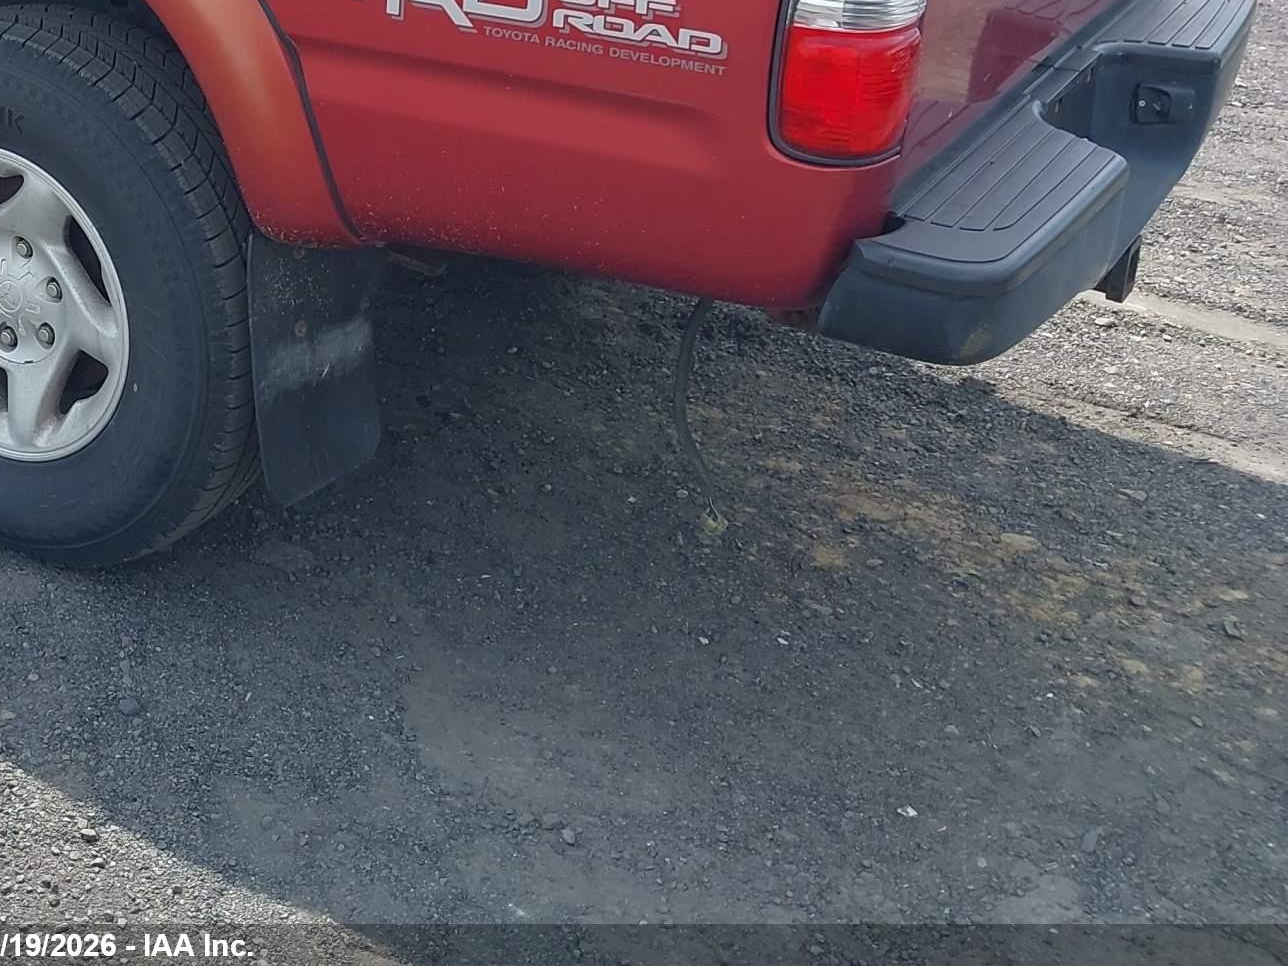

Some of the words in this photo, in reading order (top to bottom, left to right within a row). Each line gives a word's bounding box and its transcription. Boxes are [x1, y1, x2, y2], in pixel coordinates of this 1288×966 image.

[483, 25, 541, 45] TOYOTA
[544, 36, 604, 55] RACING
[608, 47, 726, 76] DEVELOPMENT
[552, 8, 728, 59] ROAD
